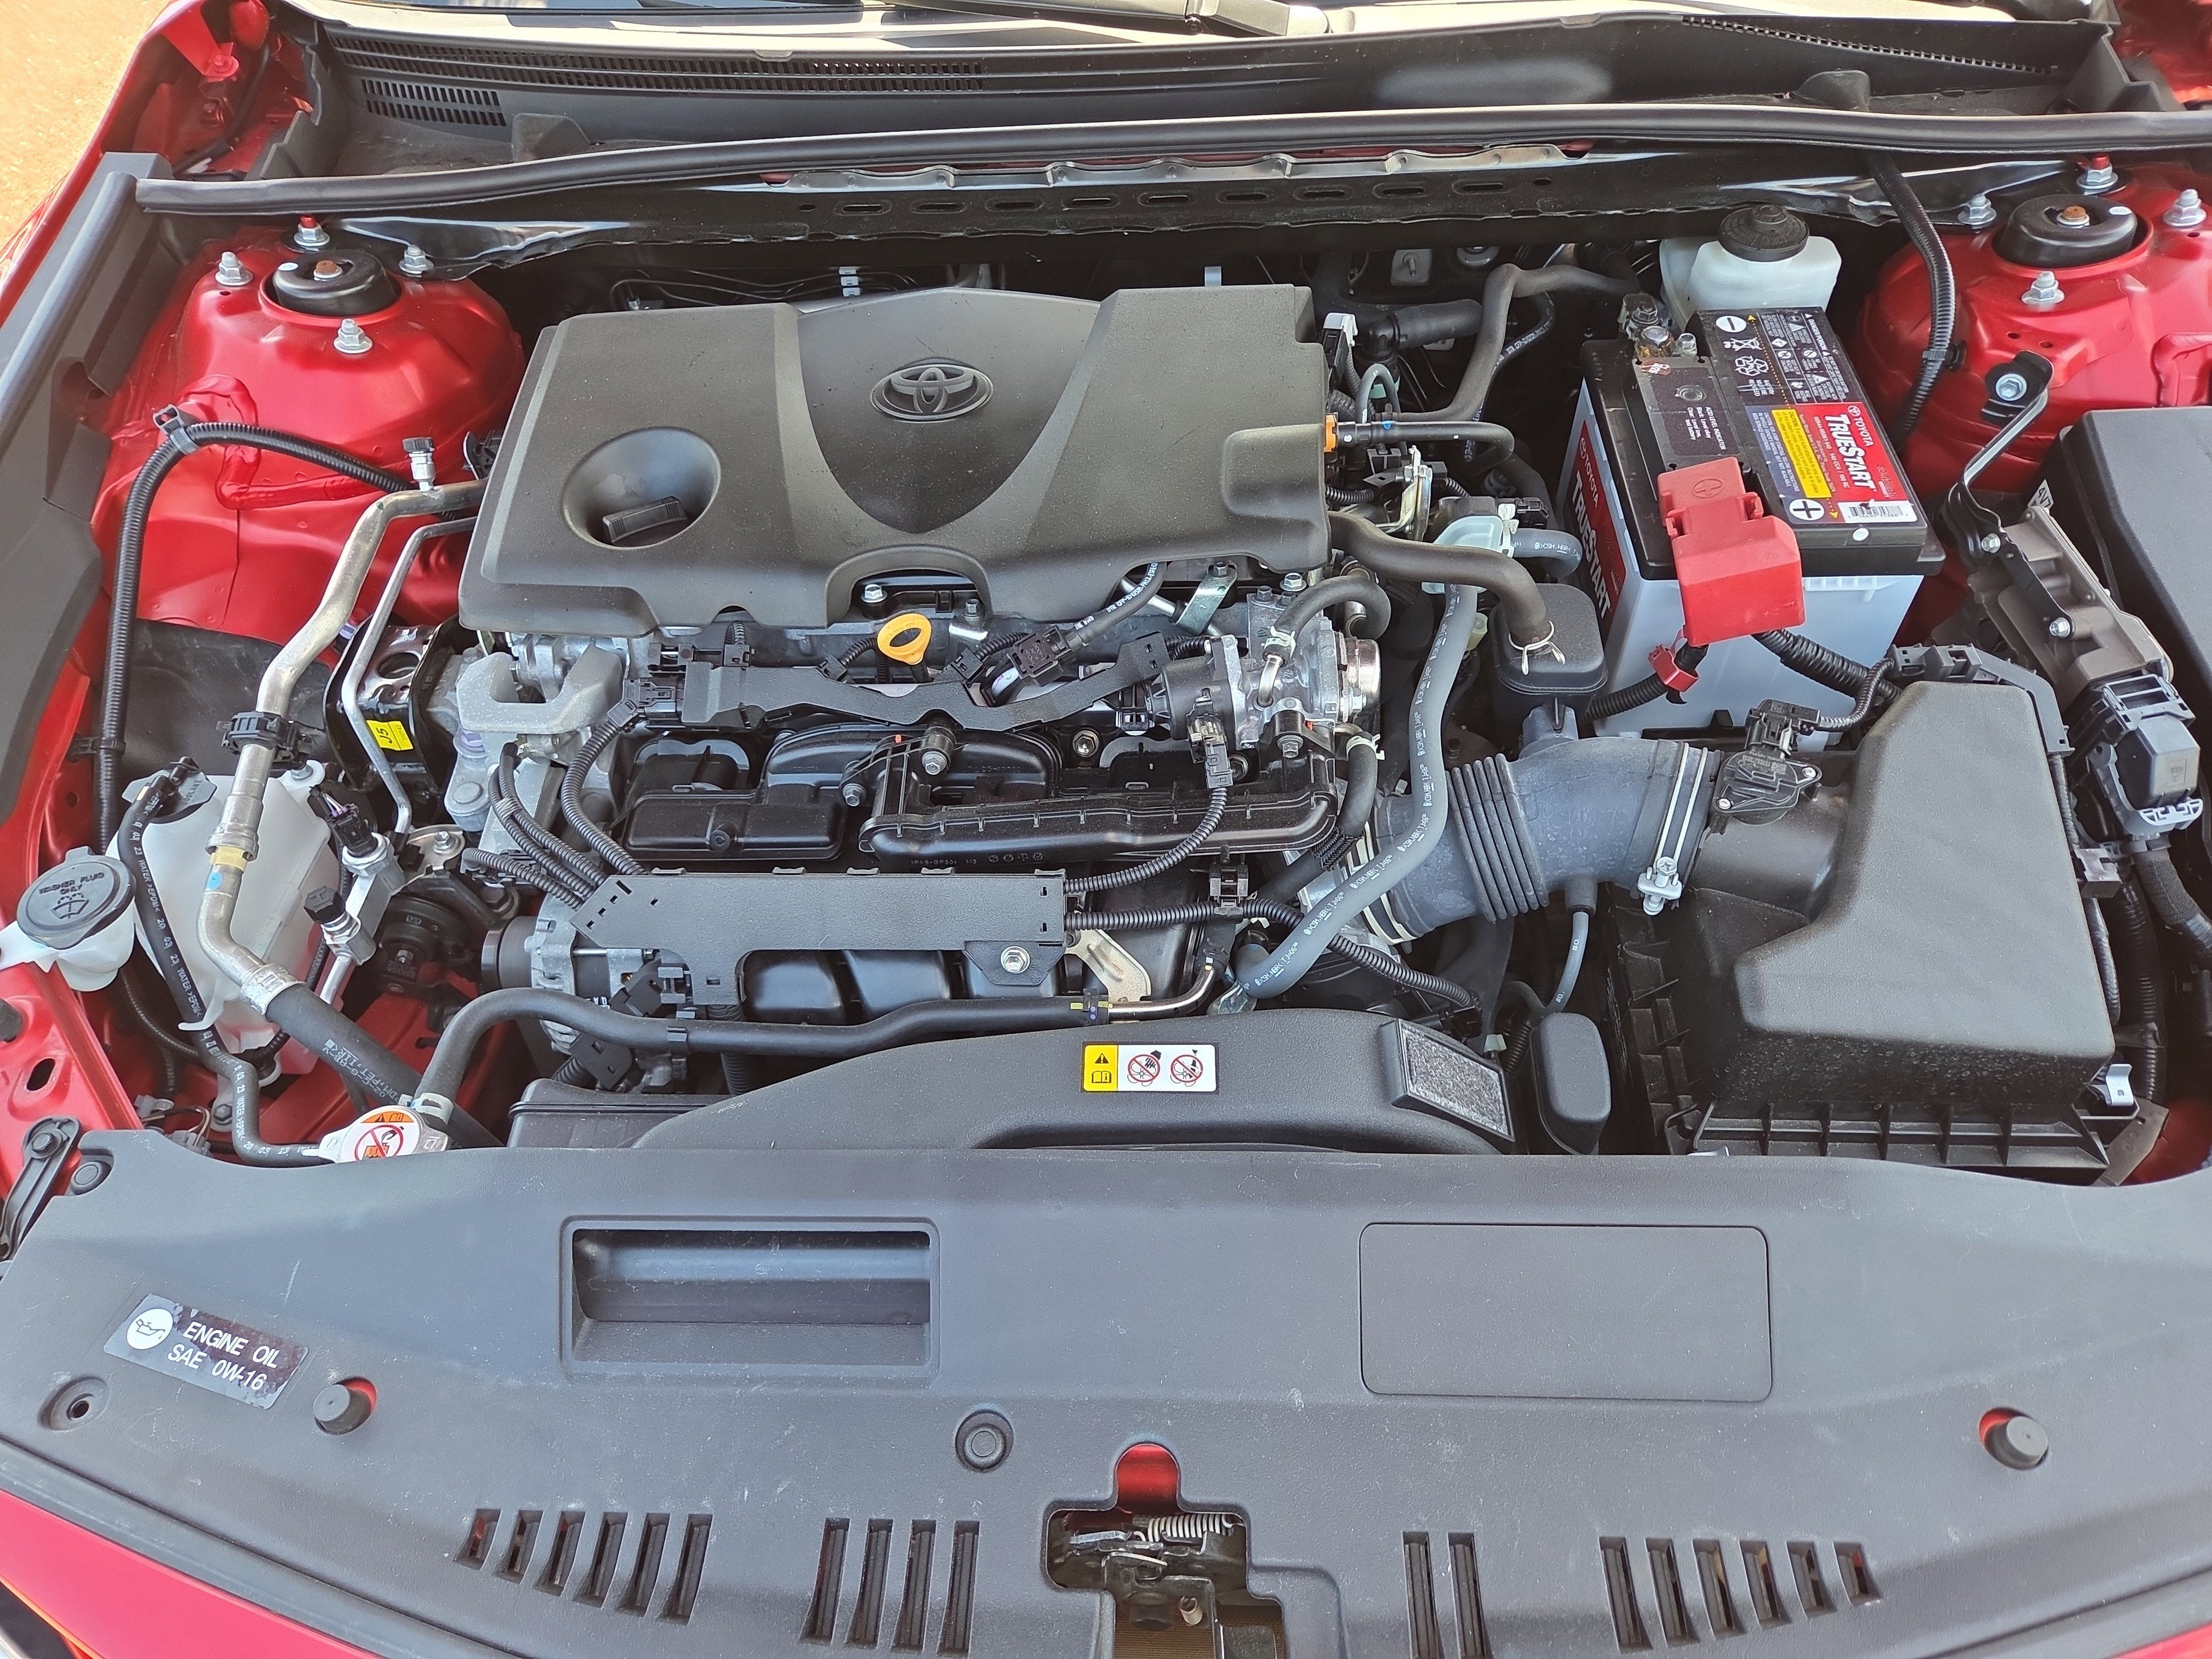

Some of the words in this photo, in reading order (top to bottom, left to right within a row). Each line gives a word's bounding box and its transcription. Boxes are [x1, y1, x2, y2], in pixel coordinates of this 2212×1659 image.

[1852, 416, 1875, 446] TOYOTA
[1585, 453, 1598, 507] TOYOTA
[374, 725, 393, 744] J5
[38, 879, 76, 895] WASHER
[79, 871, 105, 884] FLUID
[59, 883, 83, 895] ONLY
[183, 1322, 248, 1355] ENGINE
[252, 1346, 280, 1368] OIL
[168, 1344, 207, 1369] SAE
[211, 1359, 267, 1391] 0W-16
